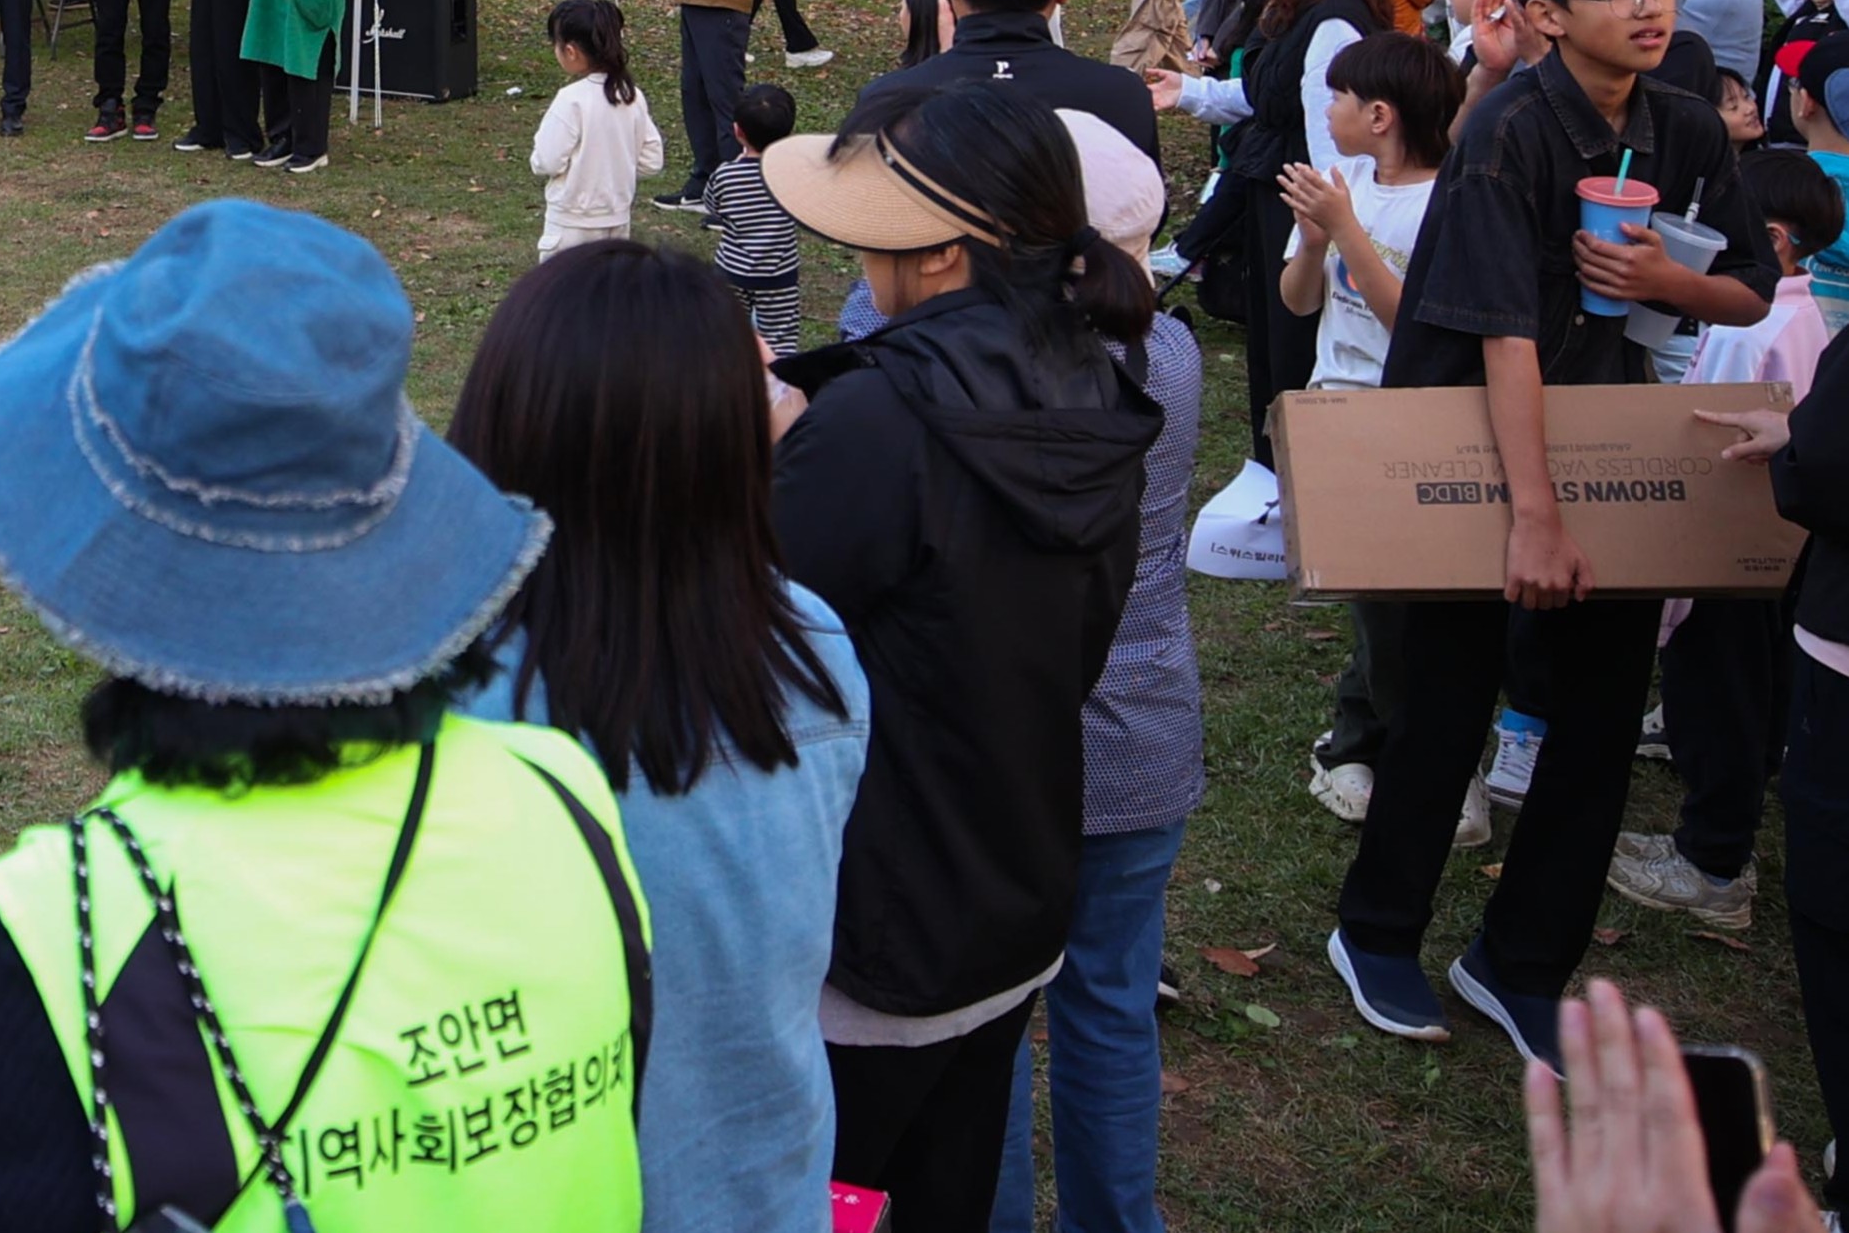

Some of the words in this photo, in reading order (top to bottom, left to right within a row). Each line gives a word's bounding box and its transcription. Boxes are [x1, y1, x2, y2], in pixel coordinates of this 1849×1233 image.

[1384, 460, 1483, 479] CLEANER
[1595, 457, 1713, 476] CORDLESS
[1418, 484, 1479, 503] BLDC
[1584, 480, 1686, 502] BROWN
[399, 989, 533, 1088] 조안면
